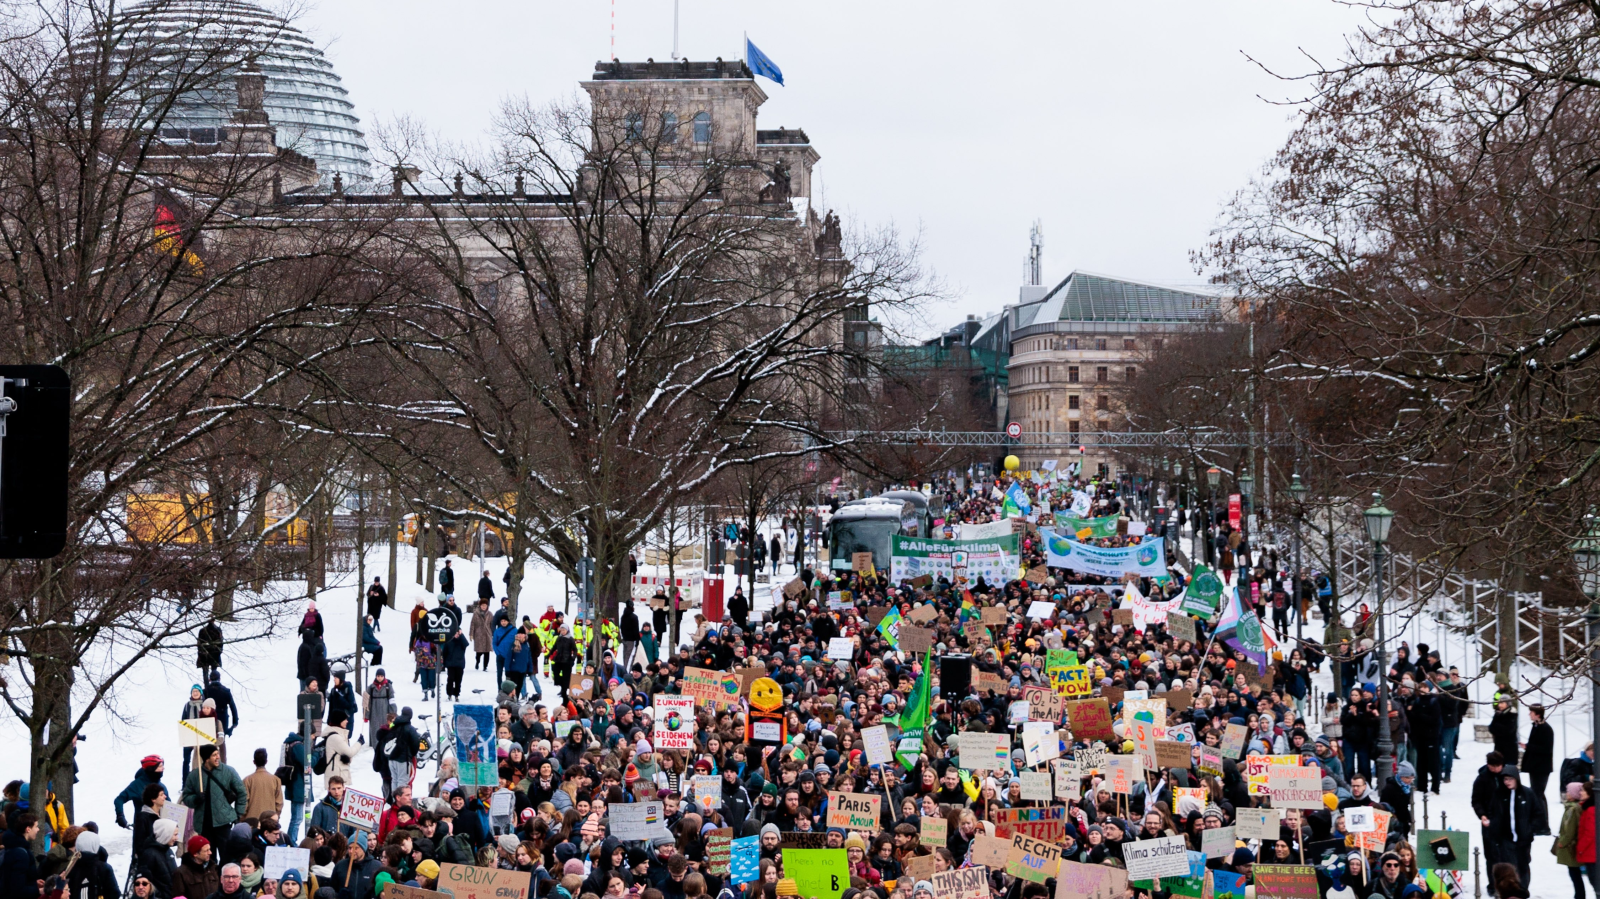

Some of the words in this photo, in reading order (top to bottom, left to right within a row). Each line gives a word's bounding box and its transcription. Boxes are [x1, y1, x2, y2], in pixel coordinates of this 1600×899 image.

[1134, 594, 1150, 608] Wir
[1154, 601, 1181, 613] haben
[700, 670, 715, 679] THE
[980, 673, 997, 681] GANZ
[1058, 669, 1084, 682] ACT
[683, 688, 717, 700] HOTTER
[696, 682, 724, 694] GETTING
[1057, 682, 1088, 694] NOW
[656, 699, 694, 708] ZUKUNFT
[1049, 692, 1059, 704] is
[1076, 702, 1096, 711] eine
[1073, 708, 1108, 722] Zukunft
[655, 730, 693, 740] SEIDENEN
[1136, 725, 1146, 742] 5
[661, 739, 688, 747] FADEN
[1248, 762, 1264, 776] IST
[1269, 768, 1316, 780] KLIMASCHUTZ
[634, 781, 654, 790] MAKE
[1288, 779, 1298, 788] IST
[350, 793, 374, 808] STOP
[1270, 789, 1323, 802] MENSCHENSCHUTZ
[837, 795, 873, 815] PARIS,
[348, 804, 377, 824] PLASTIK
[996, 807, 1065, 823] HANDELN!
[922, 822, 947, 833] ZUKUNFT
[1013, 821, 1058, 840] JETZT!
[1013, 835, 1060, 861] RECHT
[1123, 843, 1148, 860] Klima
[1151, 840, 1186, 856] schützen
[787, 852, 814, 866] There's
[1021, 854, 1047, 868] AUF
[449, 865, 498, 885] GRÜN
[1255, 866, 1274, 874] SAVE
[1275, 866, 1291, 874] THE
[1293, 866, 1316, 875] BEES
[831, 874, 840, 891] B
[934, 871, 962, 888] THIS
[936, 888, 953, 897] WHAT
